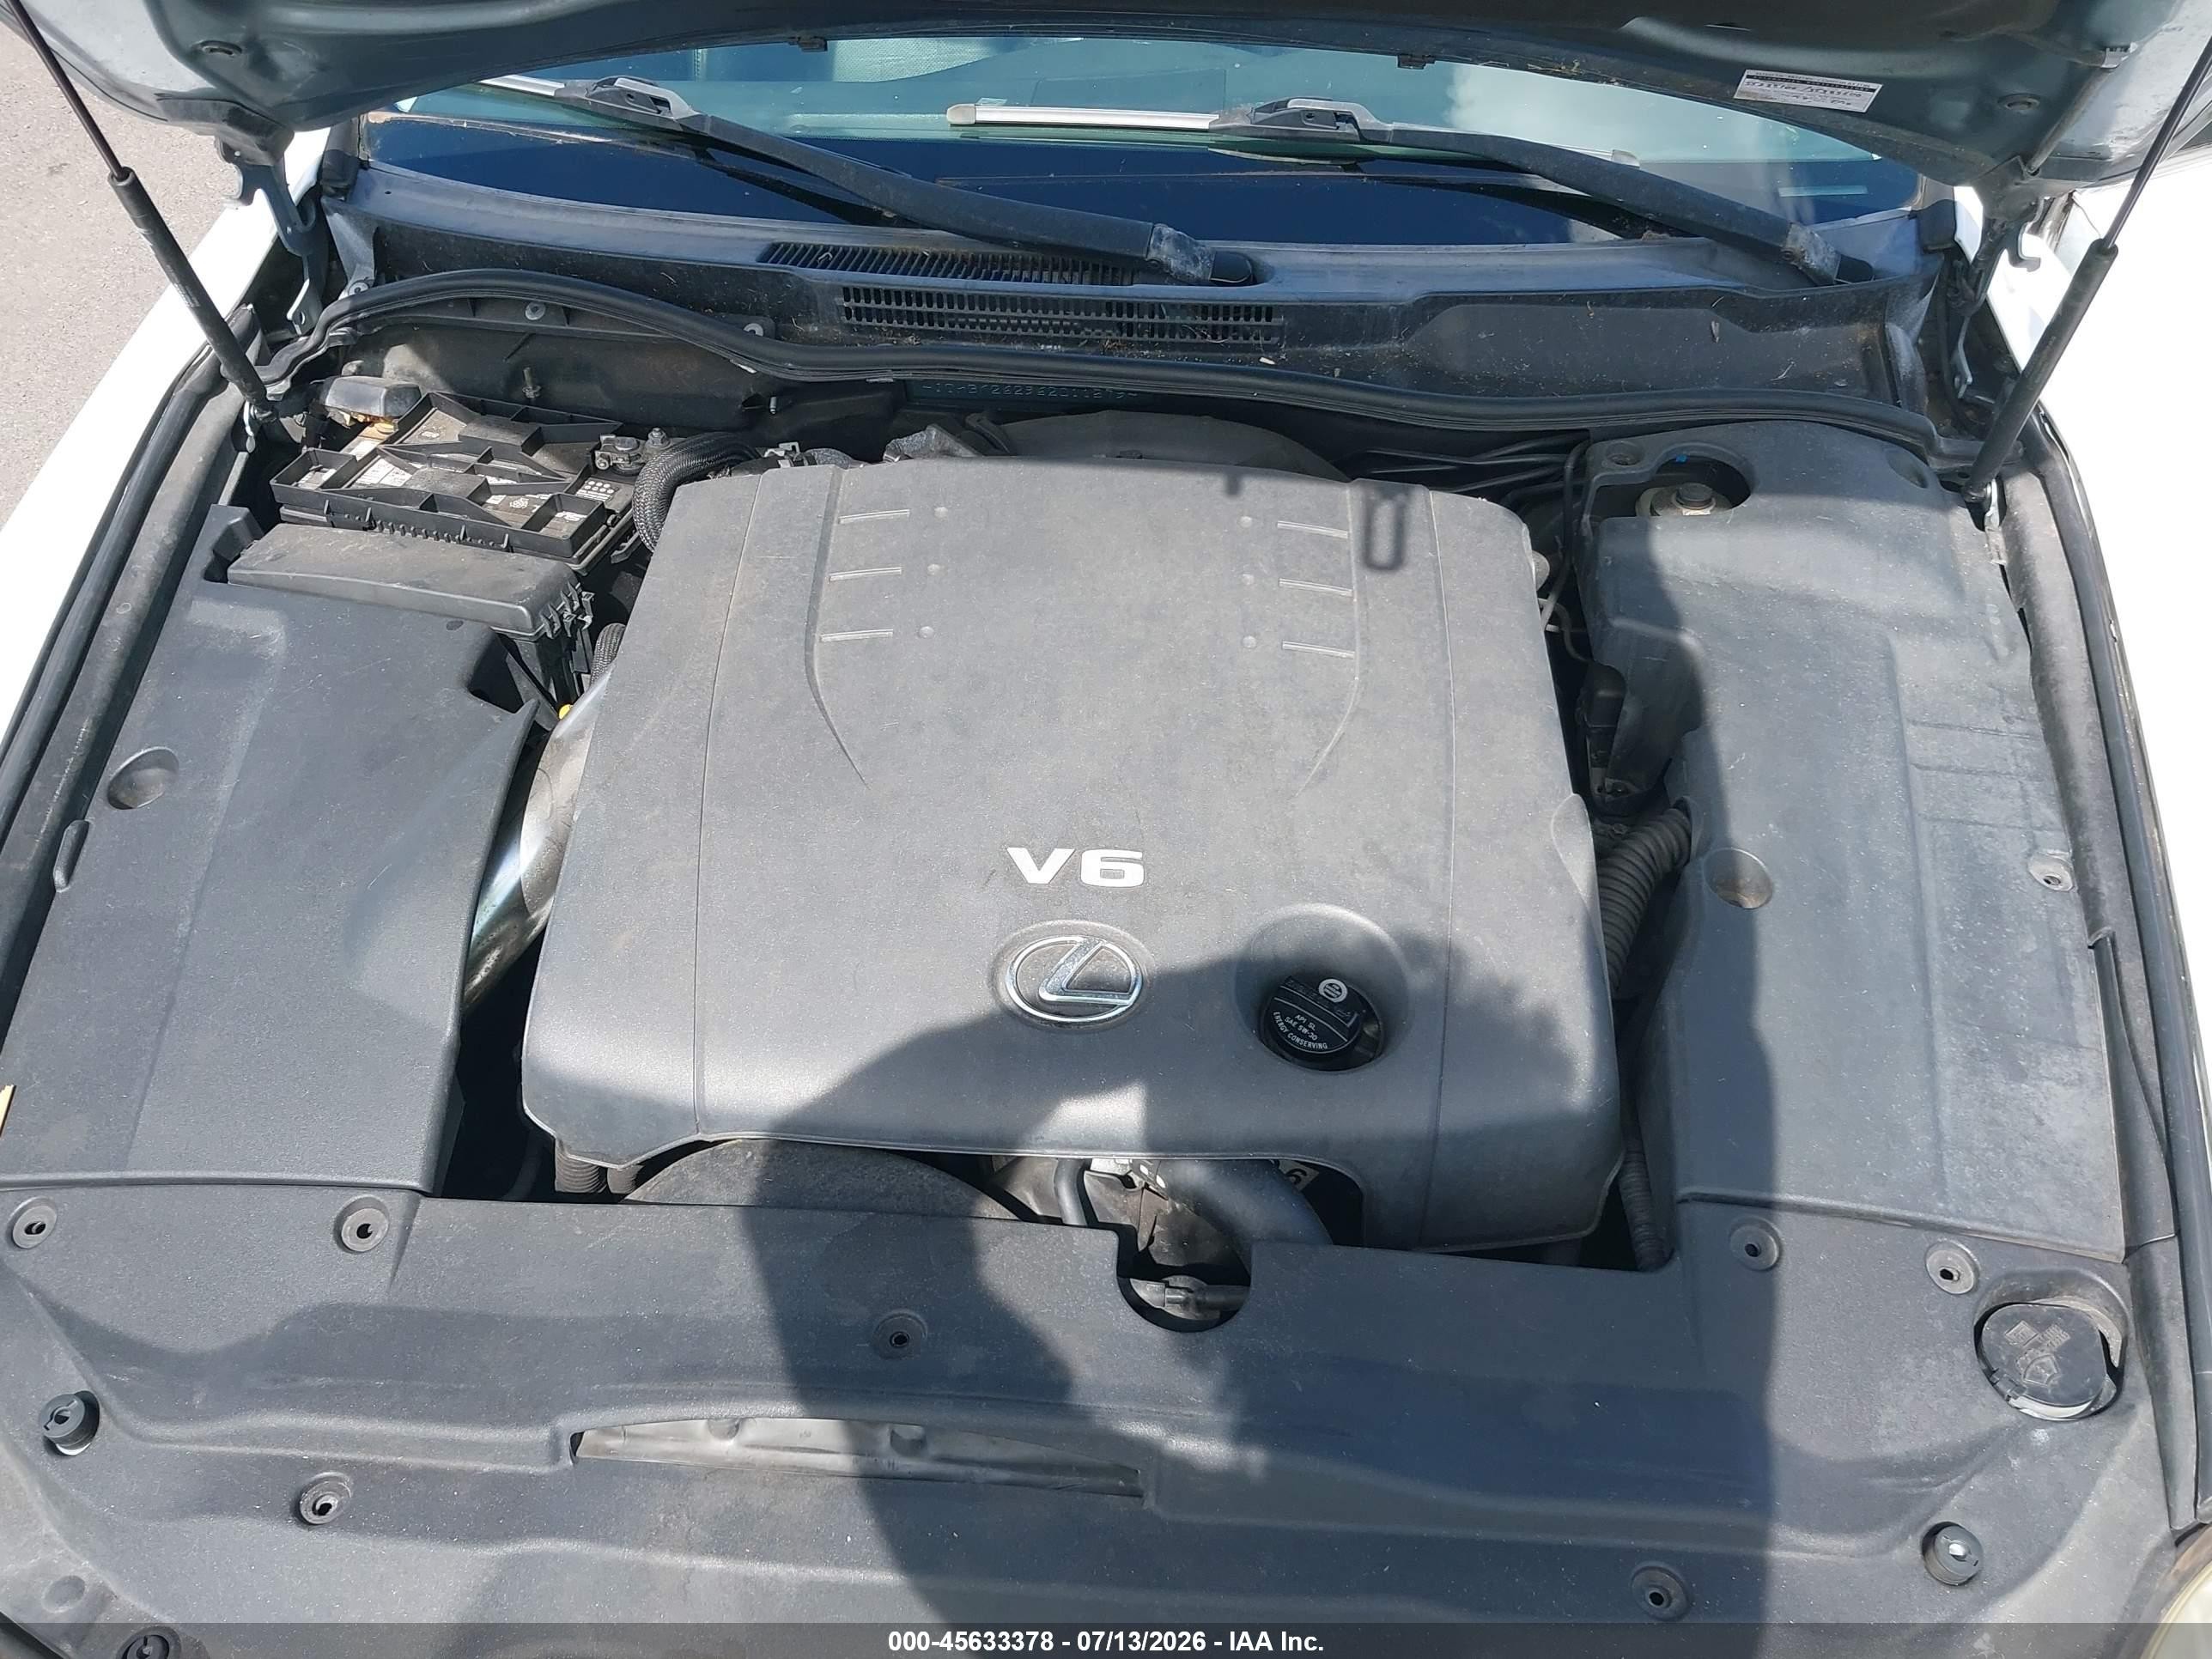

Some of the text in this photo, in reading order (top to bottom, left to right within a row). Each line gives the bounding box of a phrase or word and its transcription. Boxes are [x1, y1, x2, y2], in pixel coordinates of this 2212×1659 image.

[1006, 847, 1145, 888] V6
[1273, 1012, 1328, 1048] ENERGY CONSERVING
[1284, 1017, 1318, 1041] SAE 5W-30
[1295, 1014, 1316, 1031] API SL
